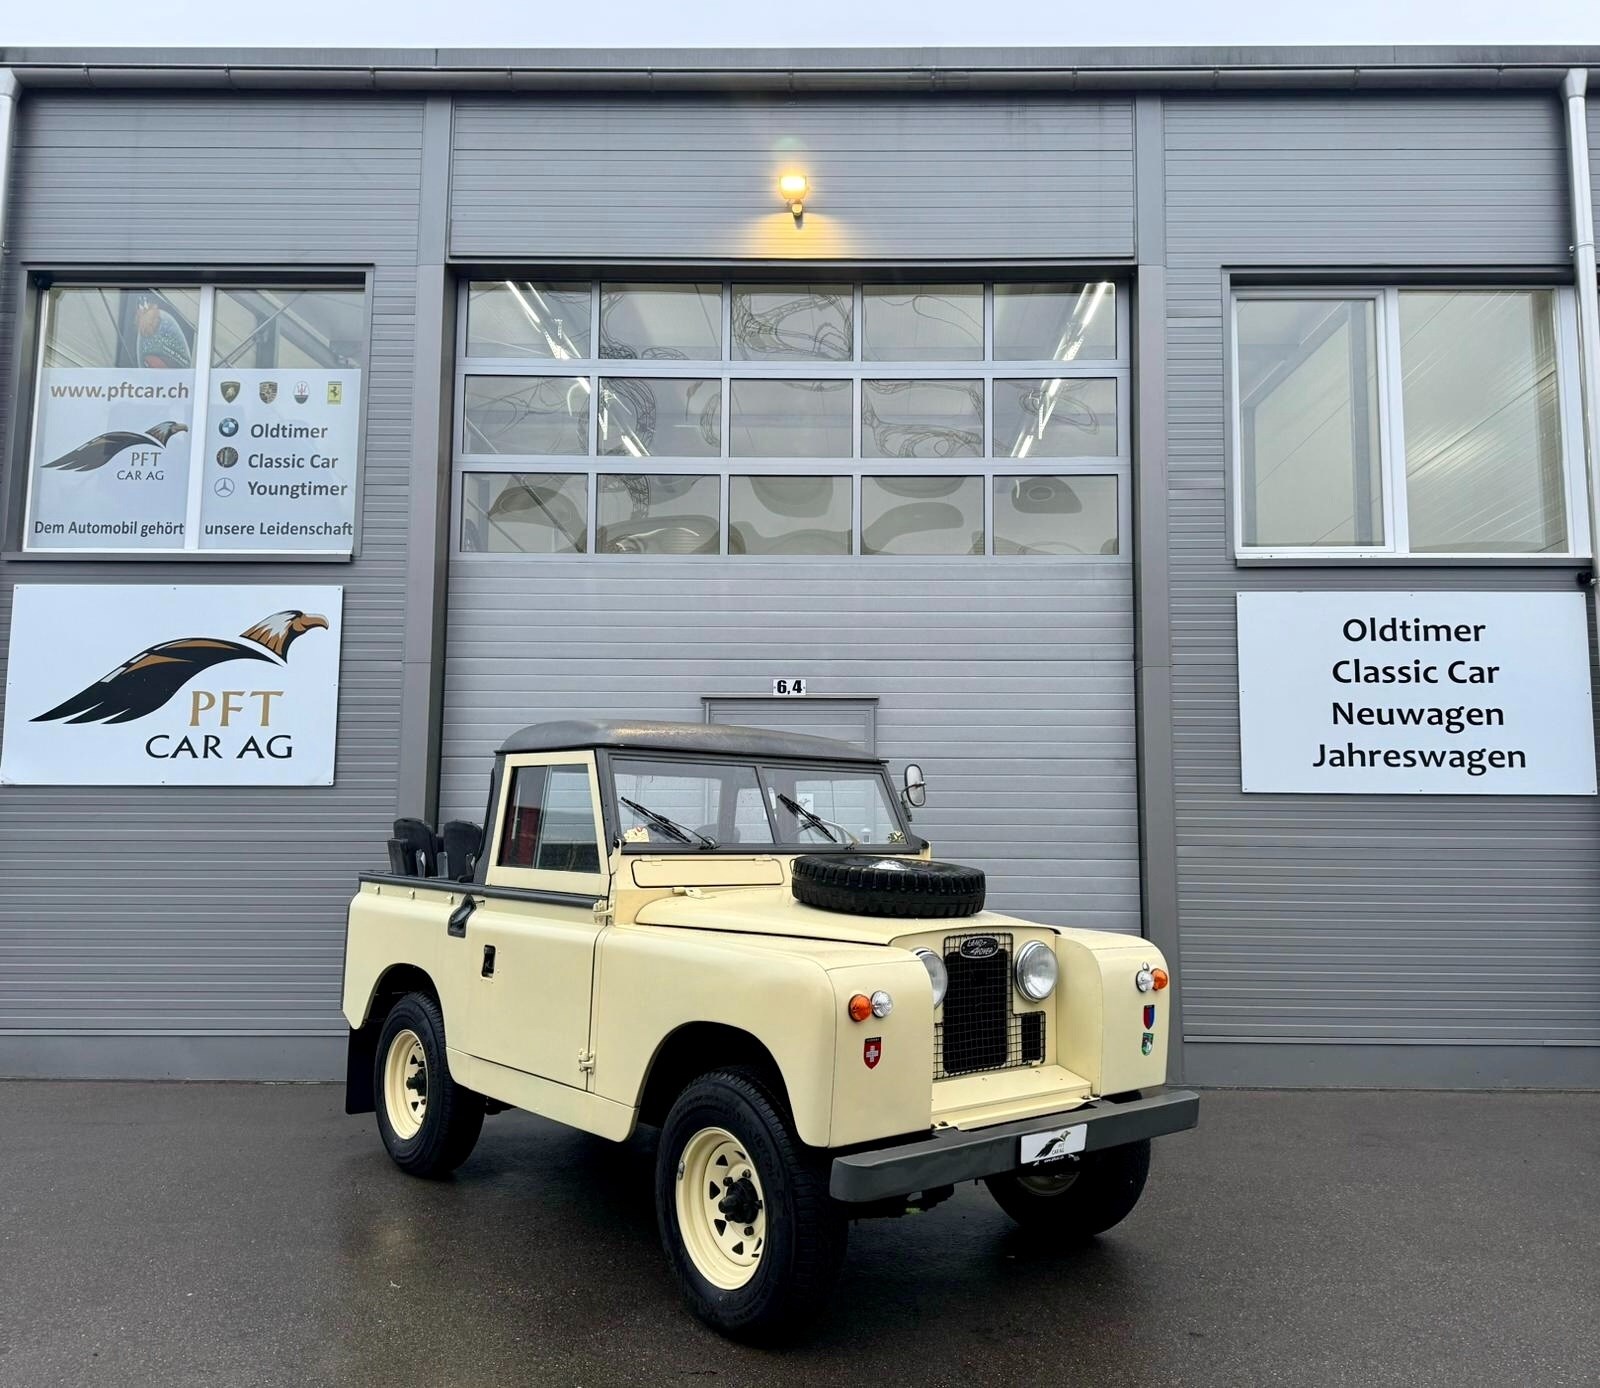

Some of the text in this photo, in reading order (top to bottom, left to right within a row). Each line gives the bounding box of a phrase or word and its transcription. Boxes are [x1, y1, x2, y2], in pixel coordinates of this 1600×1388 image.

[51, 382, 189, 401] www.pftcar.ch
[250, 423, 328, 439] Oldtimer
[131, 452, 161, 467] PFT
[248, 453, 339, 469] Classic Car
[117, 470, 165, 481] CAR AG
[248, 481, 348, 499] Youngtimer
[35, 520, 185, 538] Dem Automobil gehört
[205, 522, 353, 537] unsere Leidenschaft
[1343, 617, 1486, 642] Oldtimer
[1332, 659, 1500, 684] Classic Car
[777, 679, 803, 695] 6,4
[189, 690, 284, 727] PFT
[1332, 702, 1505, 734] Neuwagen
[145, 735, 293, 759] CAR AG
[1313, 742, 1526, 776] Jahreswagen
